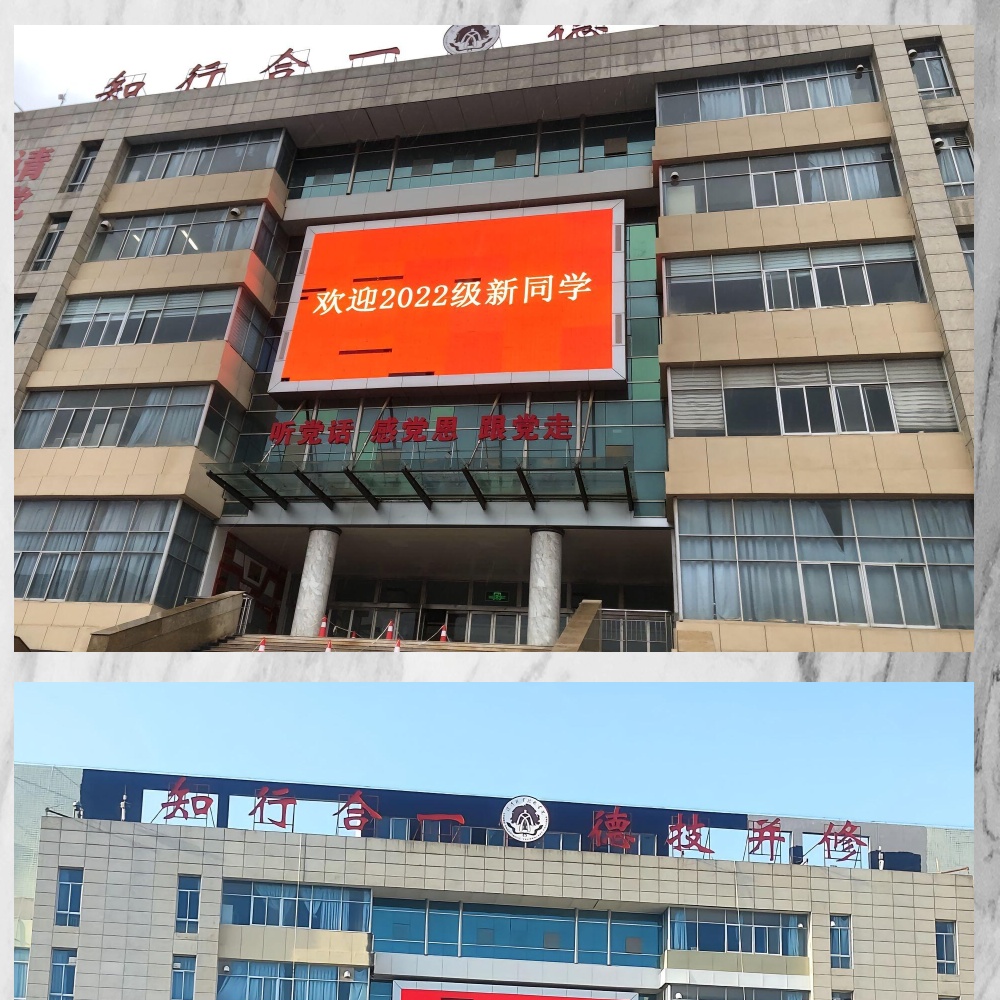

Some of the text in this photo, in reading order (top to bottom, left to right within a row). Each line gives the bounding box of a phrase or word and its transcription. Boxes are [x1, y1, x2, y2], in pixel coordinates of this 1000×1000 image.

[96, 46, 400, 101] 知行合一
[313, 272, 593, 316] 欢迎2022级新同学
[269, 412, 573, 446] 听党话 感党恩 跟党走
[161, 776, 466, 830] 知行合一
[587, 806, 868, 862] 德技并修
